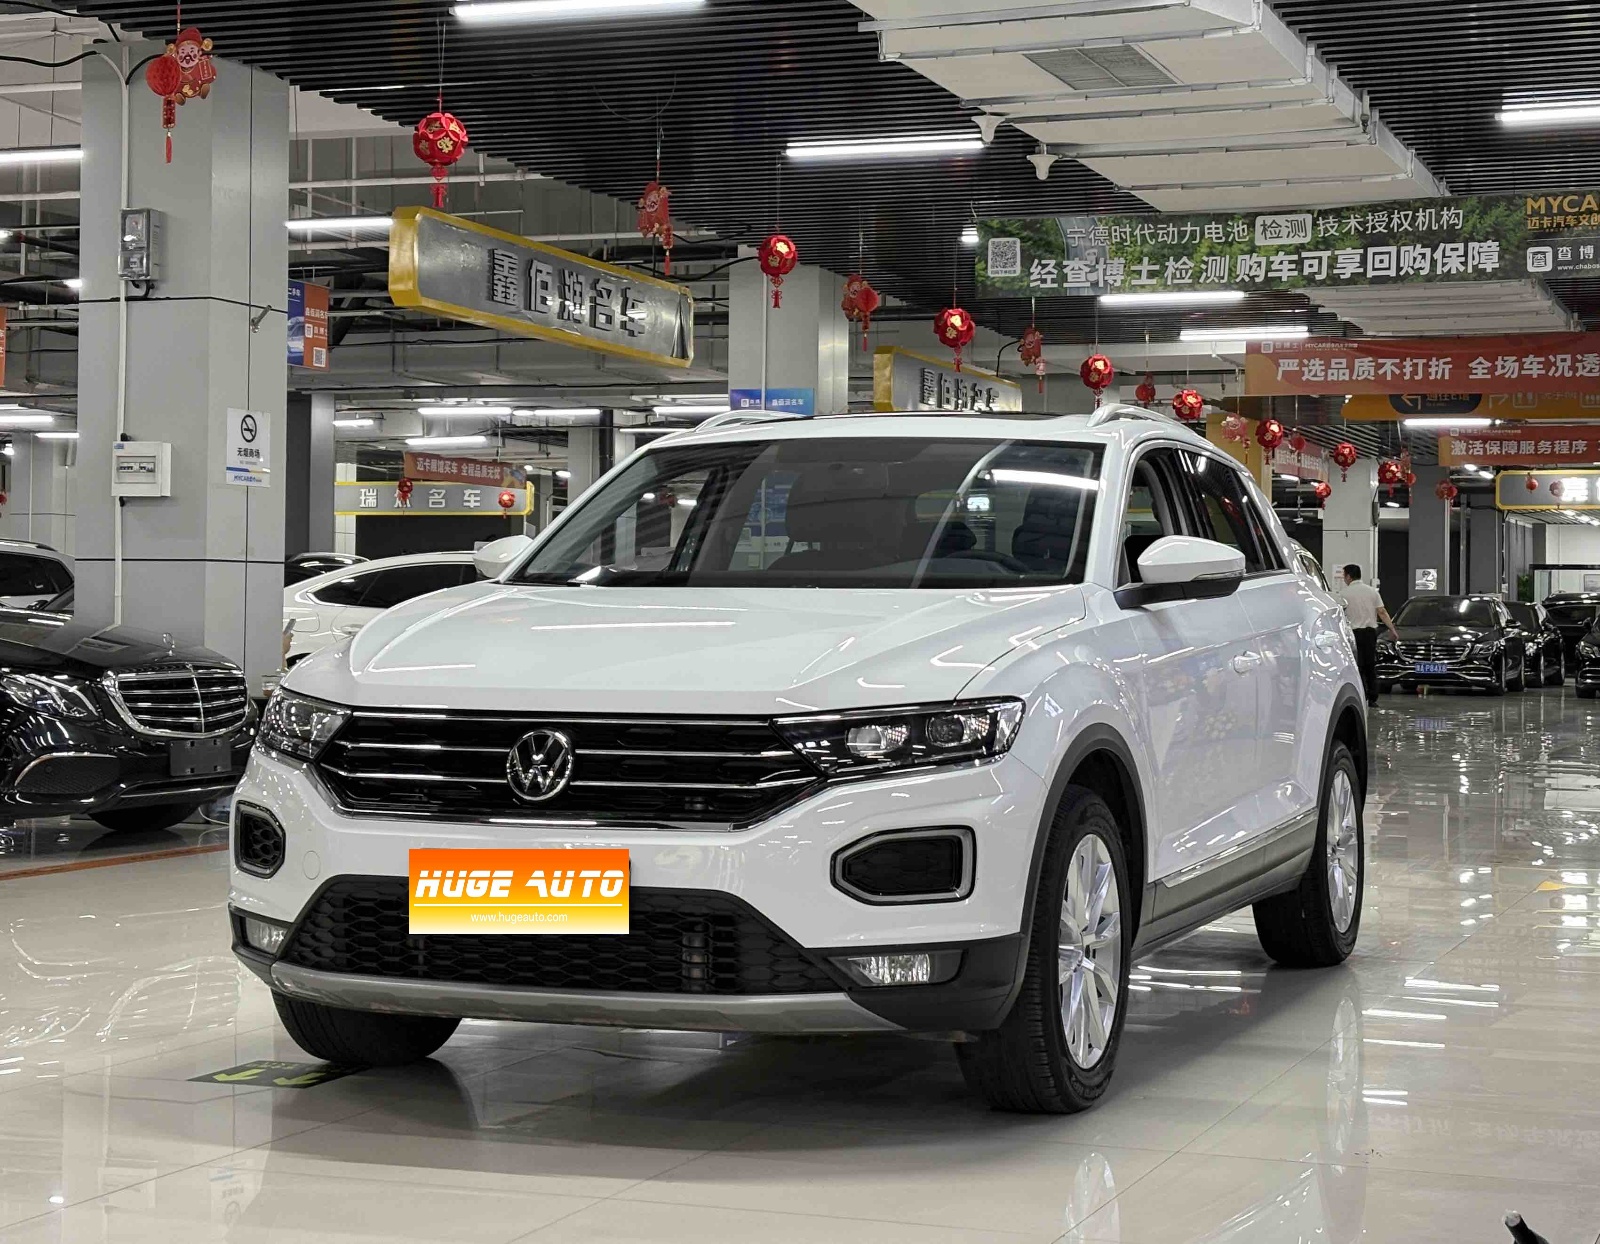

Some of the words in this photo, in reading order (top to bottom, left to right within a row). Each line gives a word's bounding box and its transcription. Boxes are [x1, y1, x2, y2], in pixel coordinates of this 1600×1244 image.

[1527, 195, 1598, 215] MYCA
[1066, 220, 1249, 247] 宁德时代动力电池
[1260, 217, 1308, 241] 检测
[1317, 206, 1464, 238] 技术授权机构
[1029, 240, 1500, 289] 经查博士检测购车可享回购保障
[489, 248, 648, 337] 鑫佰润名车
[1276, 357, 1453, 381] 严选品质不打折
[1468, 353, 1600, 379] 全场车况透
[1451, 439, 1588, 455] 激活保障服务程序
